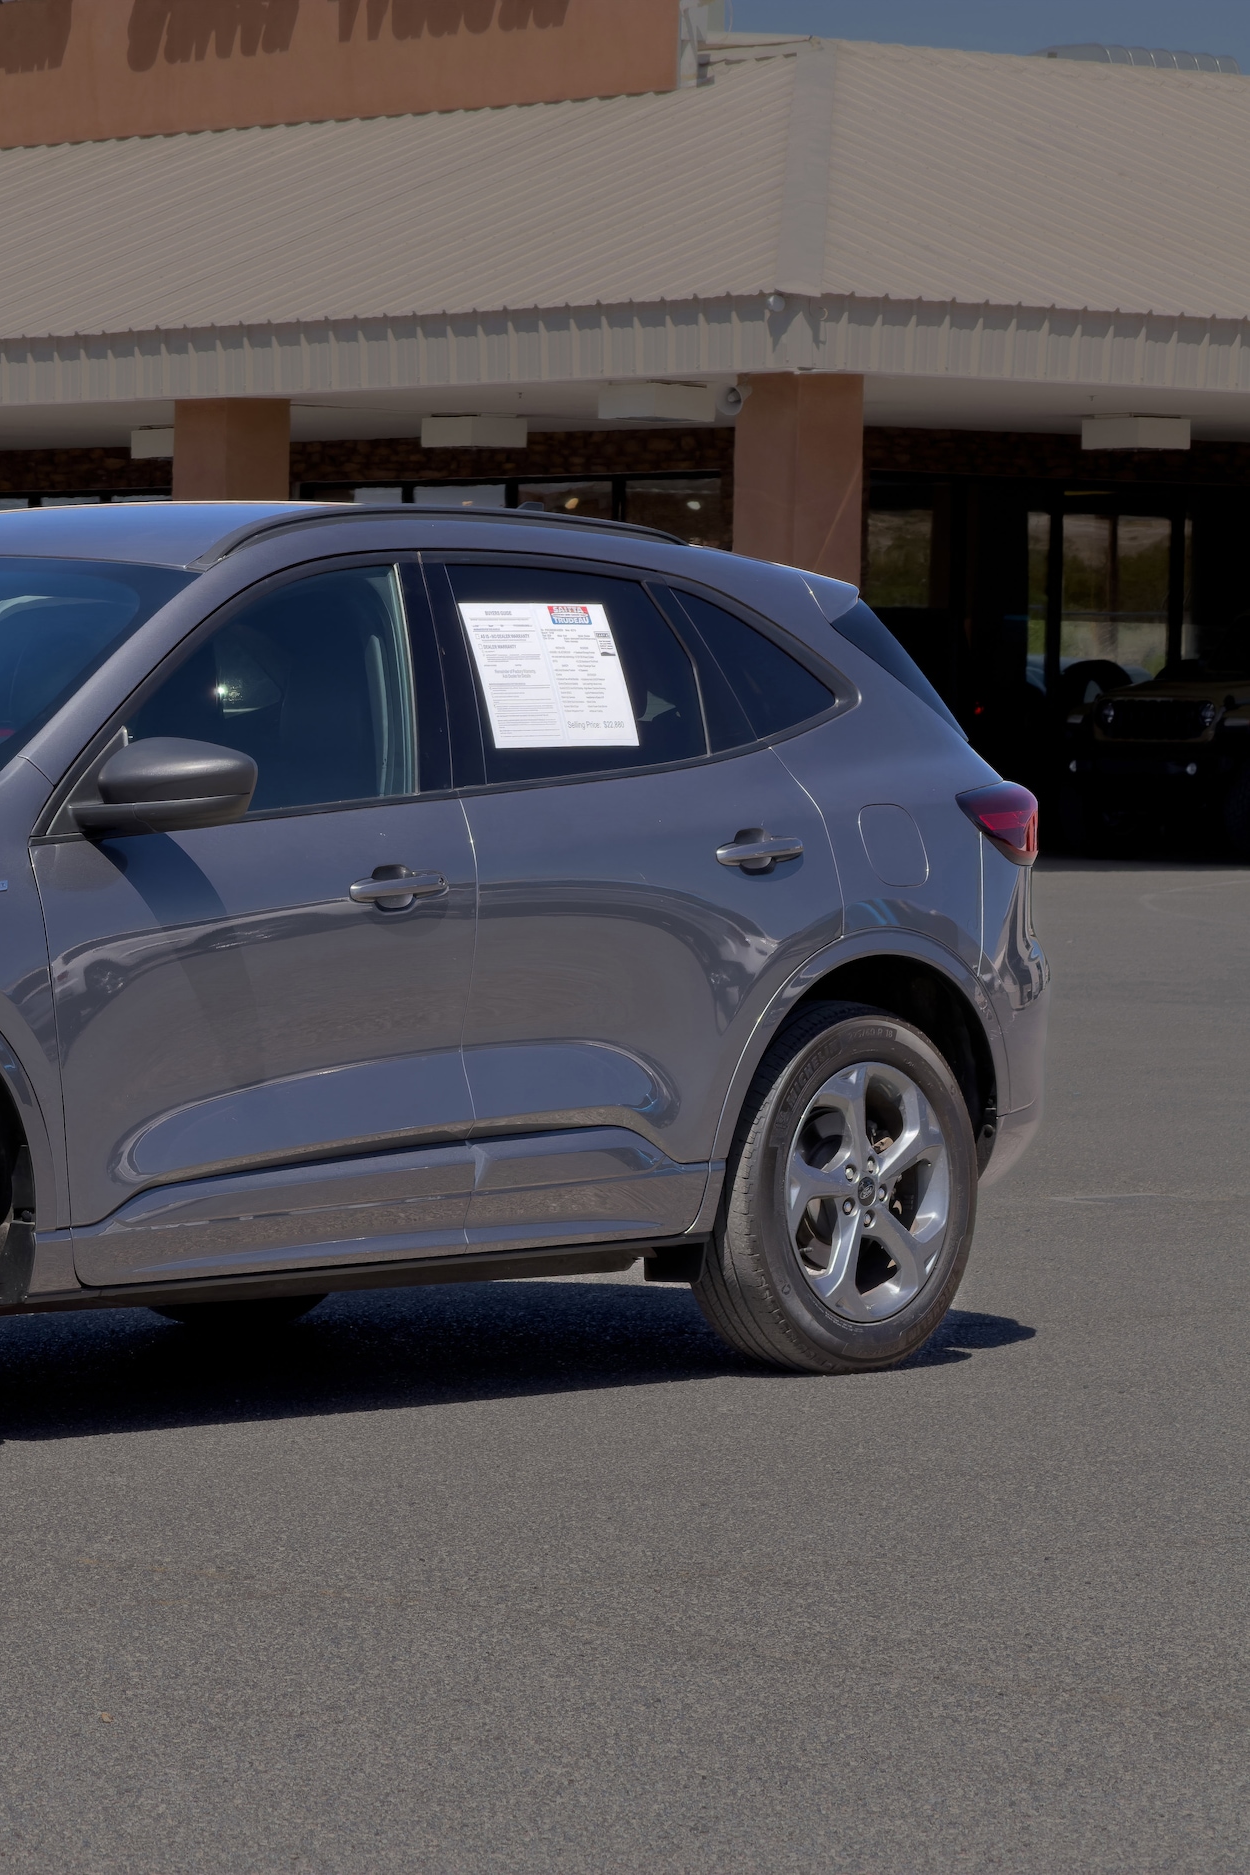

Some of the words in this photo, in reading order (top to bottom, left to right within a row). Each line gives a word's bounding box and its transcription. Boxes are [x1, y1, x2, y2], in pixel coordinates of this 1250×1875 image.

[553, 616, 589, 624] TRUDEAU
[567, 720, 585, 730] Selling
[586, 720, 601, 729] Price:
[885, 1028, 893, 1038] 18
